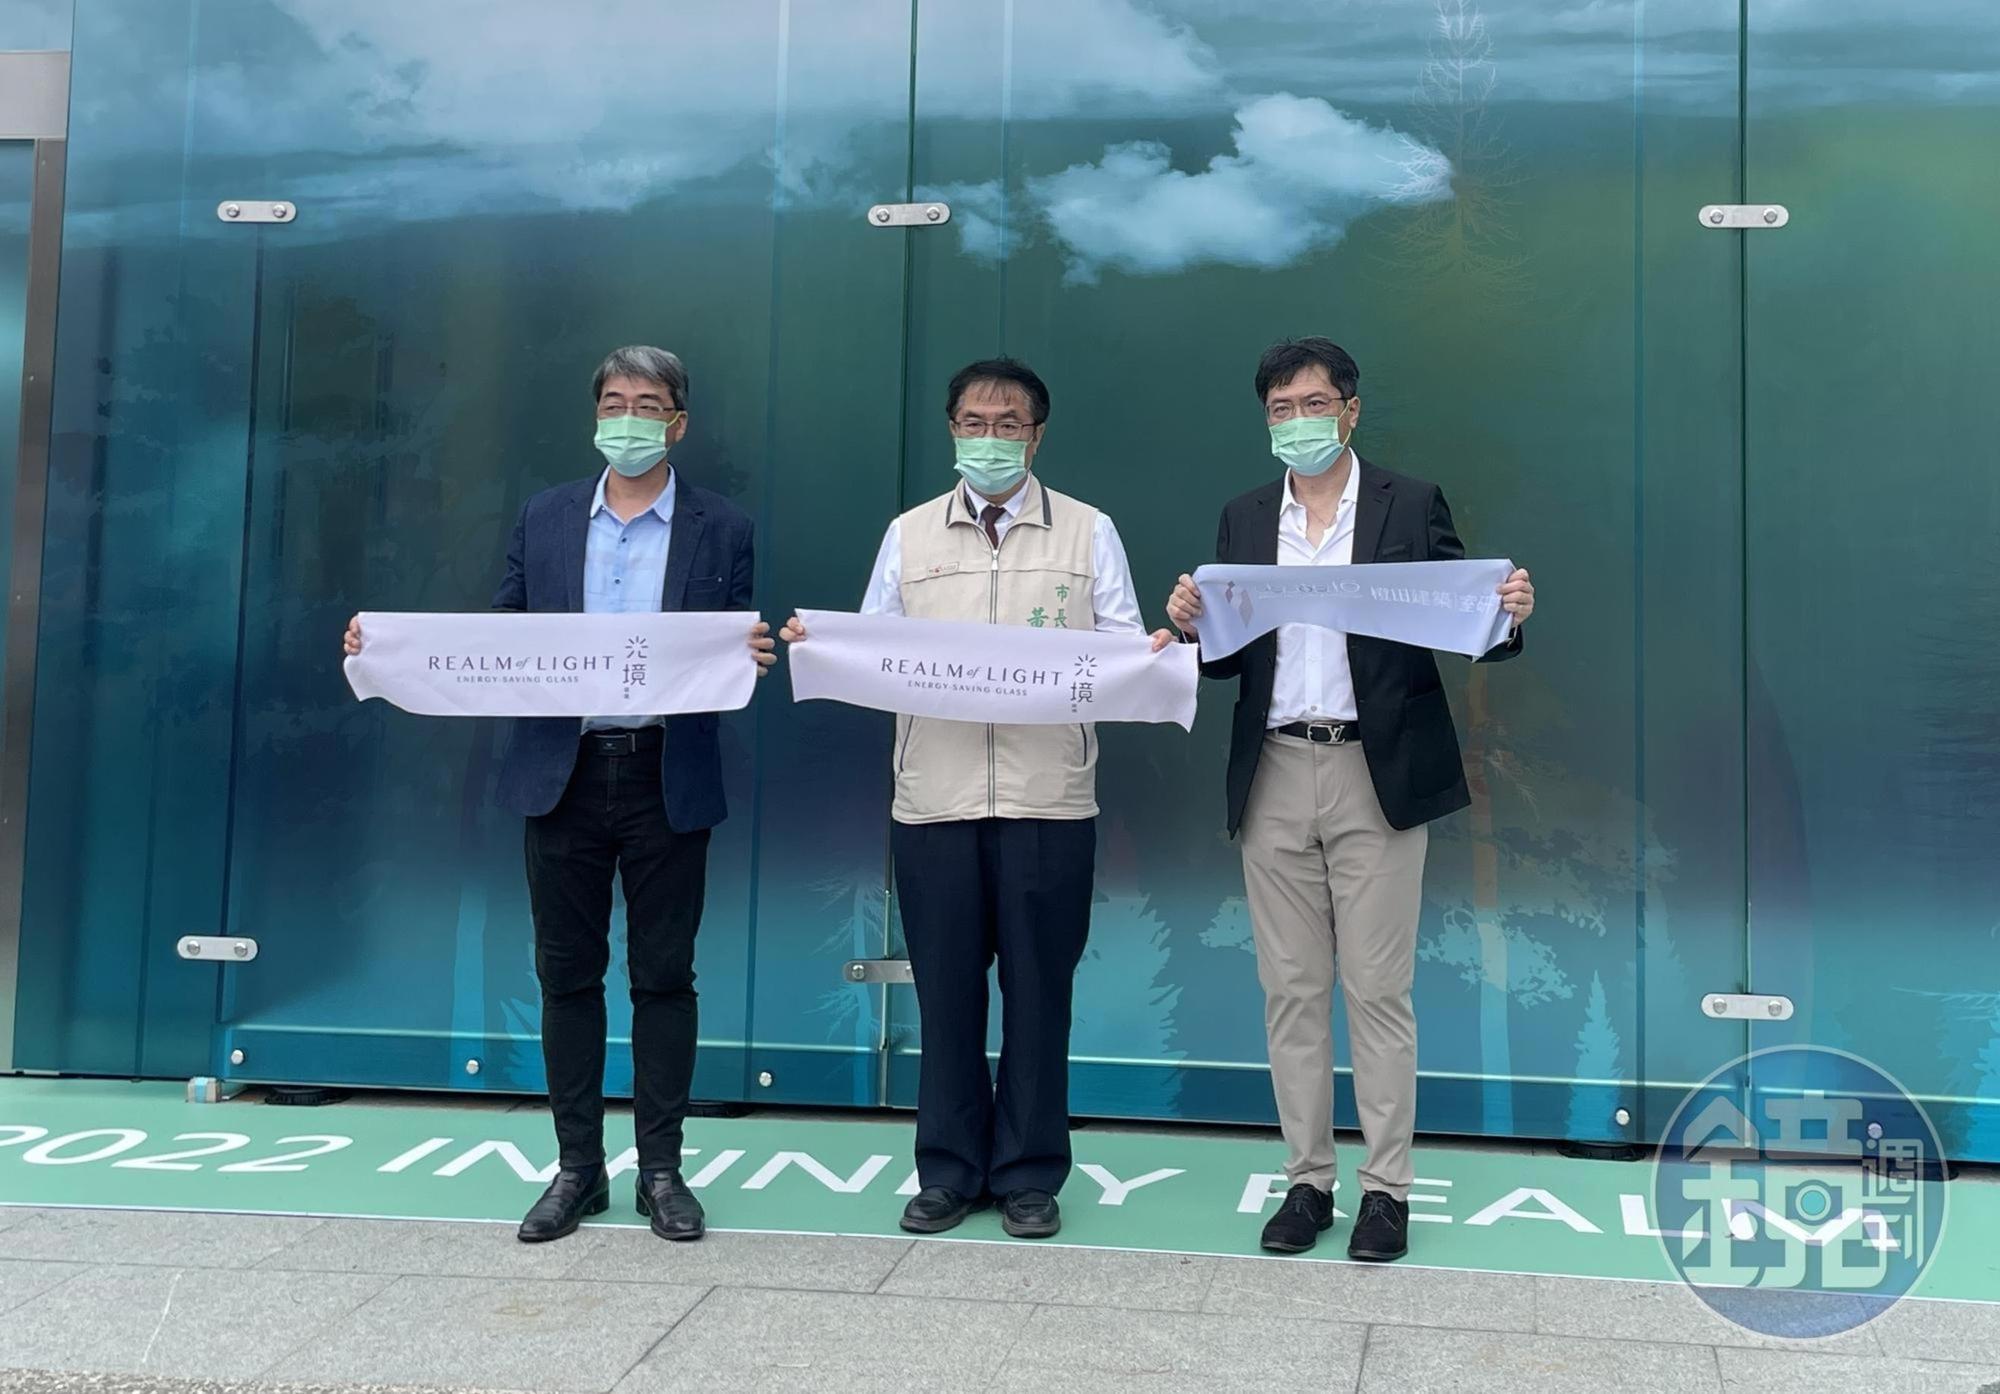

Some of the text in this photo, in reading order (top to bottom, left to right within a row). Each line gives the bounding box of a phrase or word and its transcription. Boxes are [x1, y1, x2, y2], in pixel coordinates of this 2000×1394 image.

[1054, 583, 1070, 628] 市長
[428, 655, 615, 671] REALM of LIGHT
[622, 635, 649, 686] 光境
[881, 657, 1063, 686] REALM of LIGHT
[545, 675, 579, 683] GLASS
[995, 687, 1027, 696] GLASS
[1069, 653, 1098, 703] 光境
